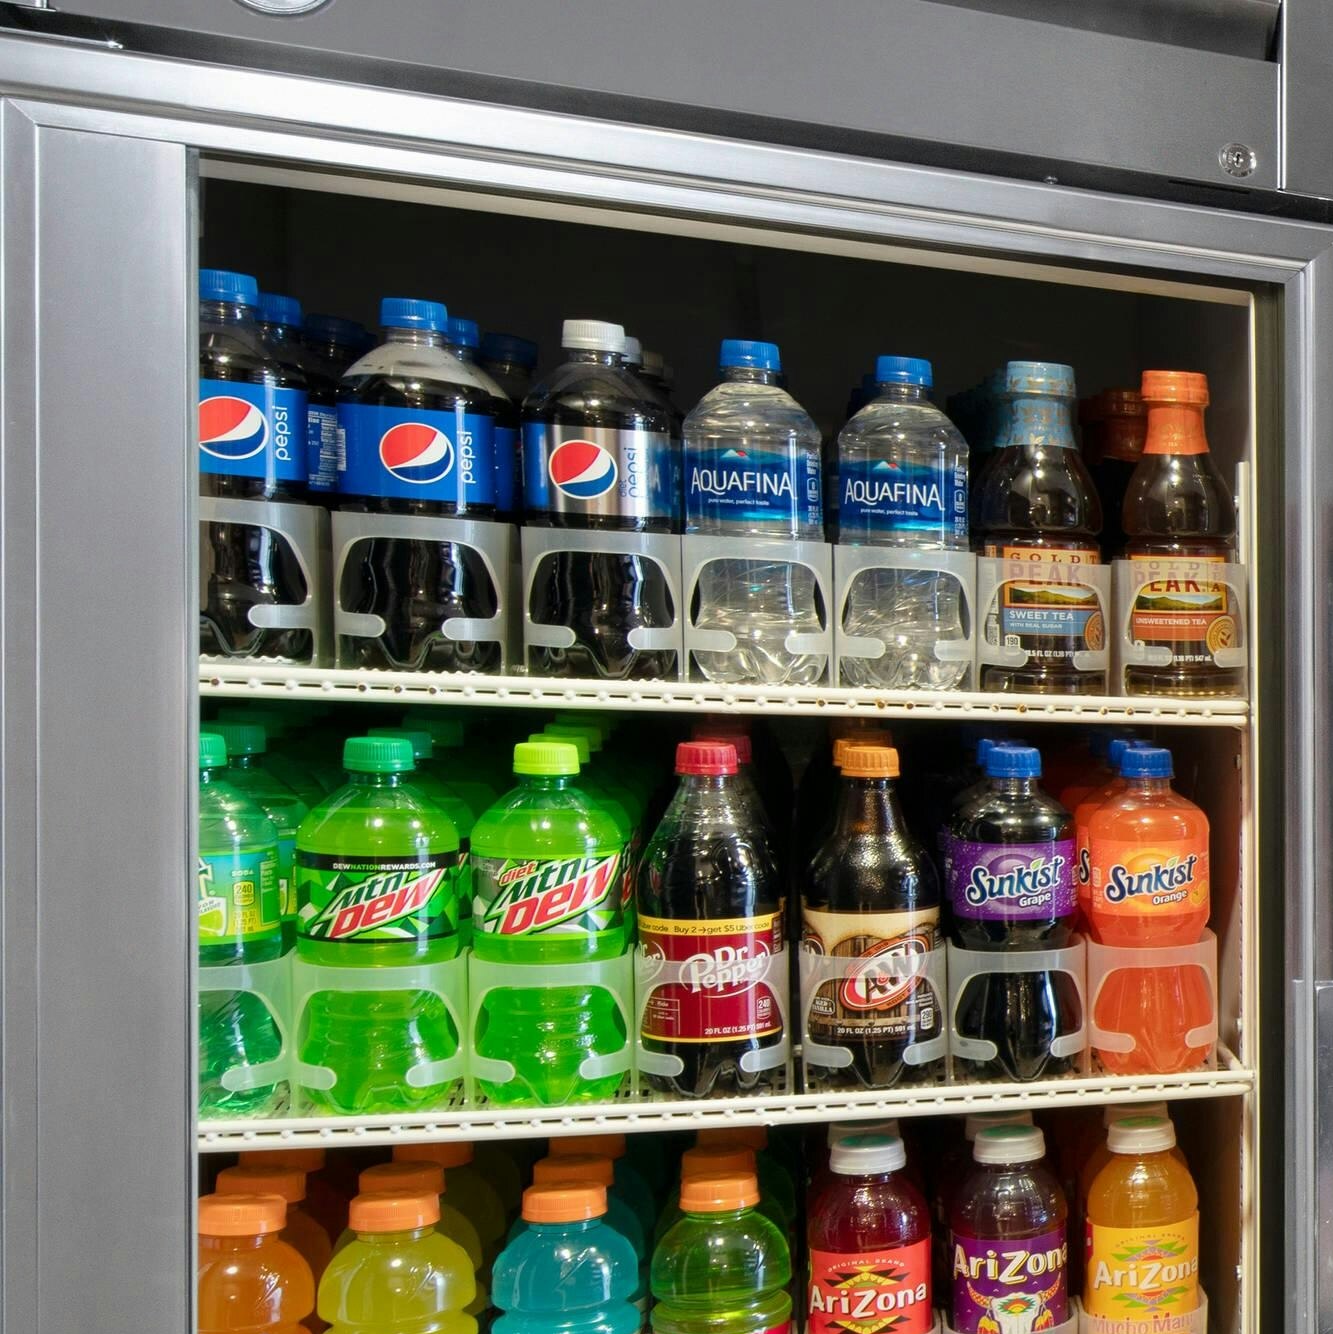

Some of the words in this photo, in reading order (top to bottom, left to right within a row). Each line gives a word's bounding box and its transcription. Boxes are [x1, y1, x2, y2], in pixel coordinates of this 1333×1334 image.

[273, 405, 291, 461] pepsi
[459, 430, 477, 484] pepsi
[690, 466, 797, 499] AQUAFINA
[845, 477, 945, 511] AQUAFINA
[1009, 611, 1050, 620] SWEET
[1052, 612, 1074, 621] TEA
[332, 861, 436, 871] DEWNATIONREWARDS.COM
[500, 861, 536, 885] diet
[966, 856, 1064, 906] Sunkist
[1106, 855, 1198, 903] Sunkist
[1019, 893, 1051, 908] Grape
[674, 925, 689, 934] Buy
[707, 925, 722, 935] get
[754, 922, 770, 930] code
[681, 948, 770, 994] Pepper
[716, 945, 749, 966] Dr
[1094, 1256, 1198, 1291] AriZona
[809, 1283, 928, 1318] AriZona
